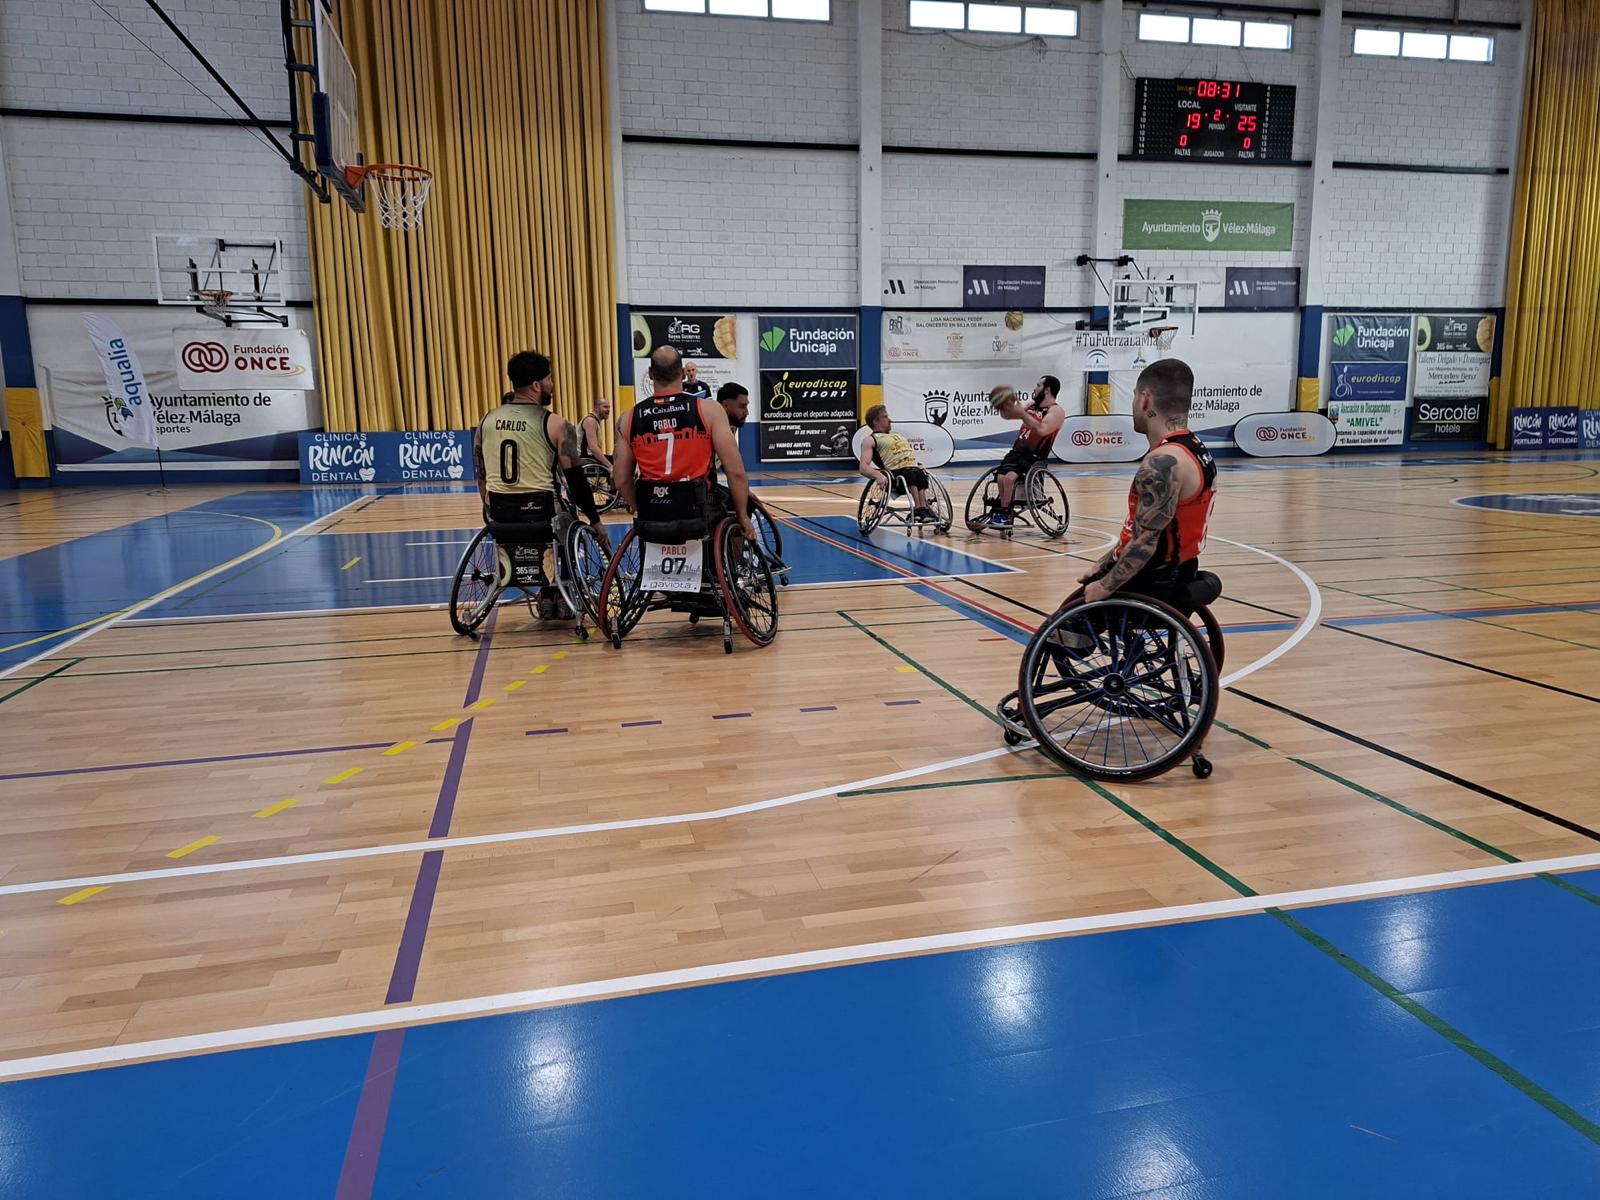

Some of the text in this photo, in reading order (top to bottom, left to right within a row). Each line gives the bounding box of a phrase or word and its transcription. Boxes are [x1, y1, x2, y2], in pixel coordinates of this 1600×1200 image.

[1197, 81, 1240, 98] 08:31
[1178, 100, 1201, 109] LOCAL
[1234, 103, 1257, 112] VISITANTE
[1187, 112, 1201, 129] 19
[1213, 109, 1221, 121] 2
[1237, 115, 1257, 132] 25
[1179, 134, 1188, 147] 0
[1243, 136, 1251, 149] 0
[1174, 148, 1191, 156] FALTAS
[1203, 150, 1225, 158] JUGADOR
[1238, 150, 1255, 159] FALTAS
[1142, 221, 1201, 235] Ayuntamiento
[1223, 222, 1276, 237] Vélez-Málaga
[789, 327, 855, 341] Fundación
[1357, 326, 1409, 337] Fundación
[233, 344, 289, 354] Fundación
[790, 341, 837, 356] Unicaja
[1357, 337, 1395, 351] Unicaja
[234, 357, 290, 370] ONCE
[109, 338, 143, 406] aqualia
[789, 379, 848, 390] eurodiscap
[1351, 374, 1401, 384] eurodiscap
[802, 390, 847, 398] SPORT
[1192, 385, 1263, 397] untamiento de
[253, 392, 272, 406] de
[652, 404, 685, 414] CaixaBank
[1190, 400, 1240, 413] lez-Málaga
[1418, 403, 1480, 420] Sercotel
[153, 409, 241, 426] élez-Málaga
[809, 410, 829, 418] deporte
[495, 419, 527, 432] CARLOS
[653, 418, 677, 430] PABLO
[952, 418, 984, 426] Deportes
[1020, 428, 1031, 439] 24
[1434, 424, 1461, 433] hotels
[315, 433, 367, 442] CLINICAS
[405, 431, 455, 440] CLINICAS
[657, 432, 675, 475] 7
[500, 439, 518, 484] 0
[312, 472, 360, 481] DENTAL
[402, 469, 449, 479] DENTAL
[661, 546, 687, 555] PABLO
[516, 567, 528, 575] 365
[661, 557, 686, 575] 07
[650, 581, 691, 589] gaviota
